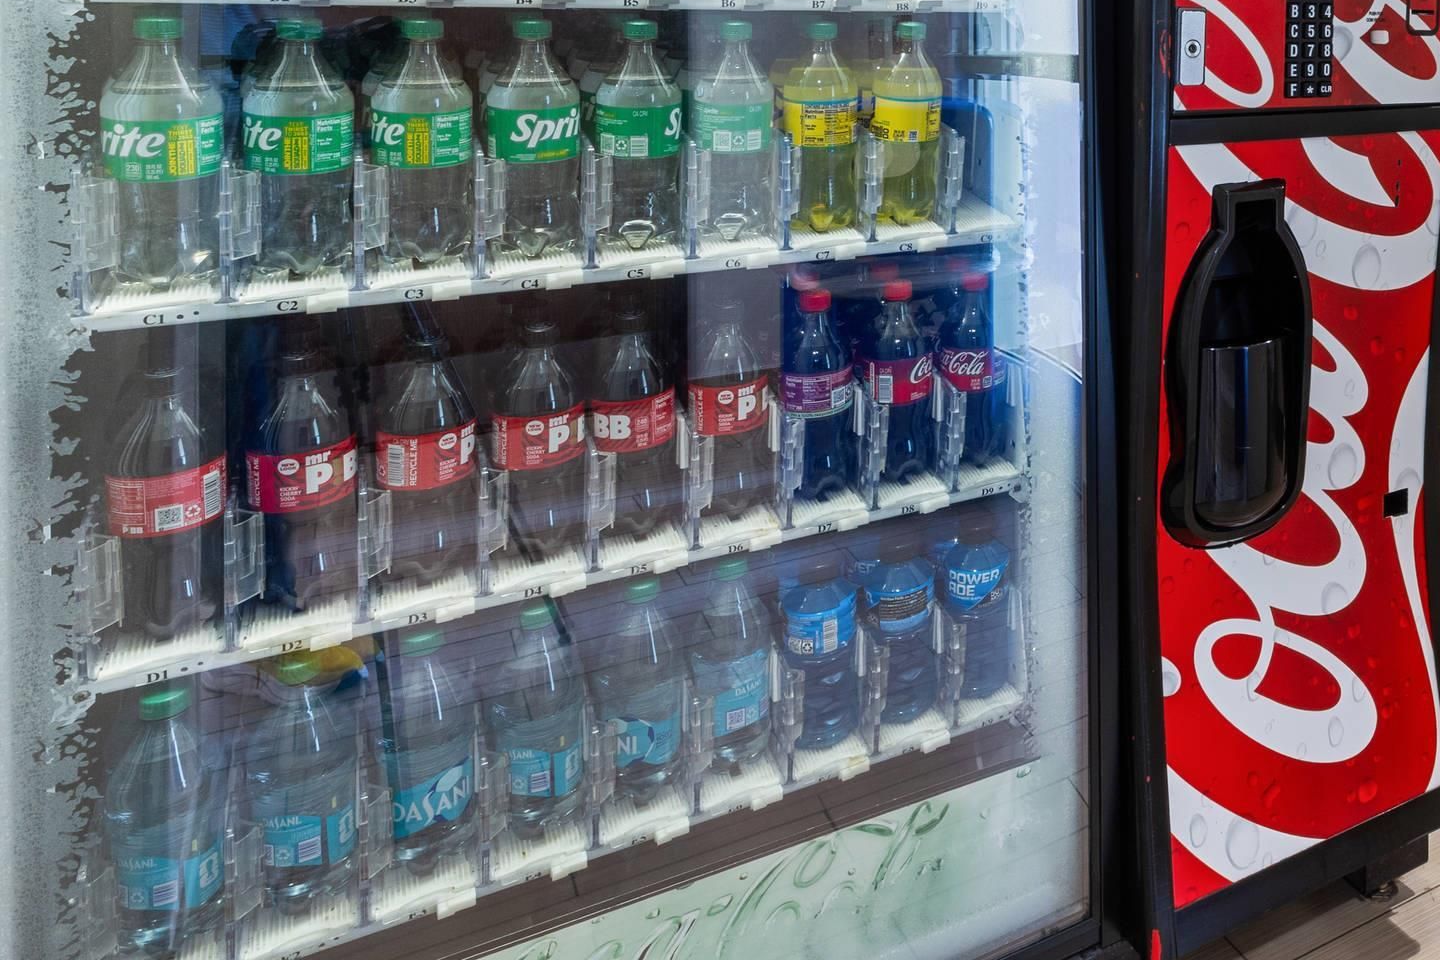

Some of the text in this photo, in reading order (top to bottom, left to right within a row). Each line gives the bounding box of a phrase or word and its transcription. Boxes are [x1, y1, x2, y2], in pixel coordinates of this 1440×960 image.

[811, 0, 826, 9] B7
[896, 3, 909, 12] B8
[1291, 5, 1332, 18] B 3 4
[1291, 24, 1331, 38] C 5 6
[1290, 44, 1331, 57] D 7 8
[1290, 64, 1330, 77] E 9 0
[1290, 83, 1332, 97] F CLR
[511, 108, 579, 149] Sprit
[102, 123, 166, 158] rite
[899, 242, 913, 253] C8
[815, 250, 830, 261] C7
[725, 258, 741, 269] C6
[627, 268, 643, 279] C5
[521, 279, 539, 289] C4
[405, 288, 424, 300] C3
[277, 300, 298, 312] C2
[143, 312, 165, 326] C1
[409, 438, 418, 486] RECYCLE ME
[982, 487, 996, 496] D9
[901, 504, 915, 515] D8
[818, 522, 832, 533] D7
[728, 543, 743, 554] D6
[631, 564, 647, 576] D5
[949, 569, 1000, 584] POWER
[524, 586, 543, 598] D4
[408, 612, 428, 625] D3
[281, 640, 303, 653] D2
[147, 669, 169, 683] D1
